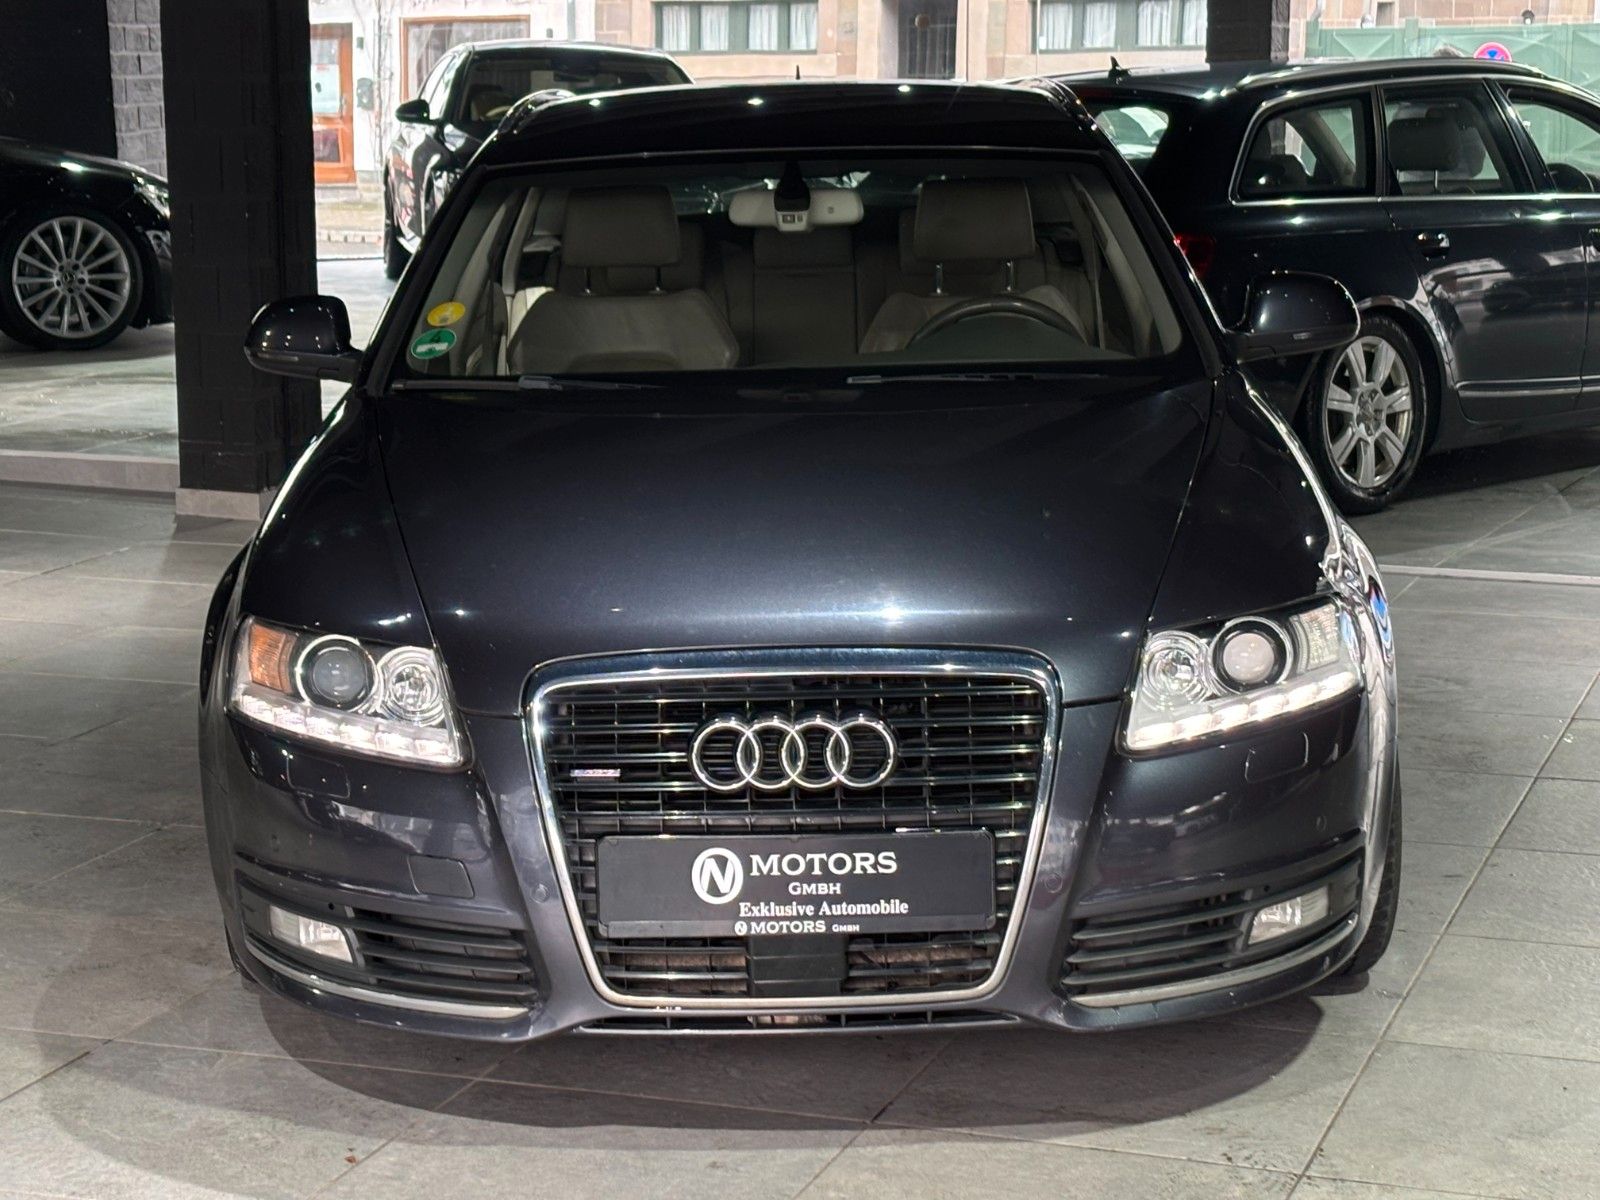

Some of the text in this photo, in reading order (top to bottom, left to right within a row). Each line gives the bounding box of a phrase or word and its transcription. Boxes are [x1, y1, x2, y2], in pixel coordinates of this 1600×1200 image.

[750, 852, 898, 876] MOTORS
[788, 882, 841, 895] GMBH
[739, 899, 909, 917] Exklusive Automobile
[750, 920, 826, 934] MOTORS
